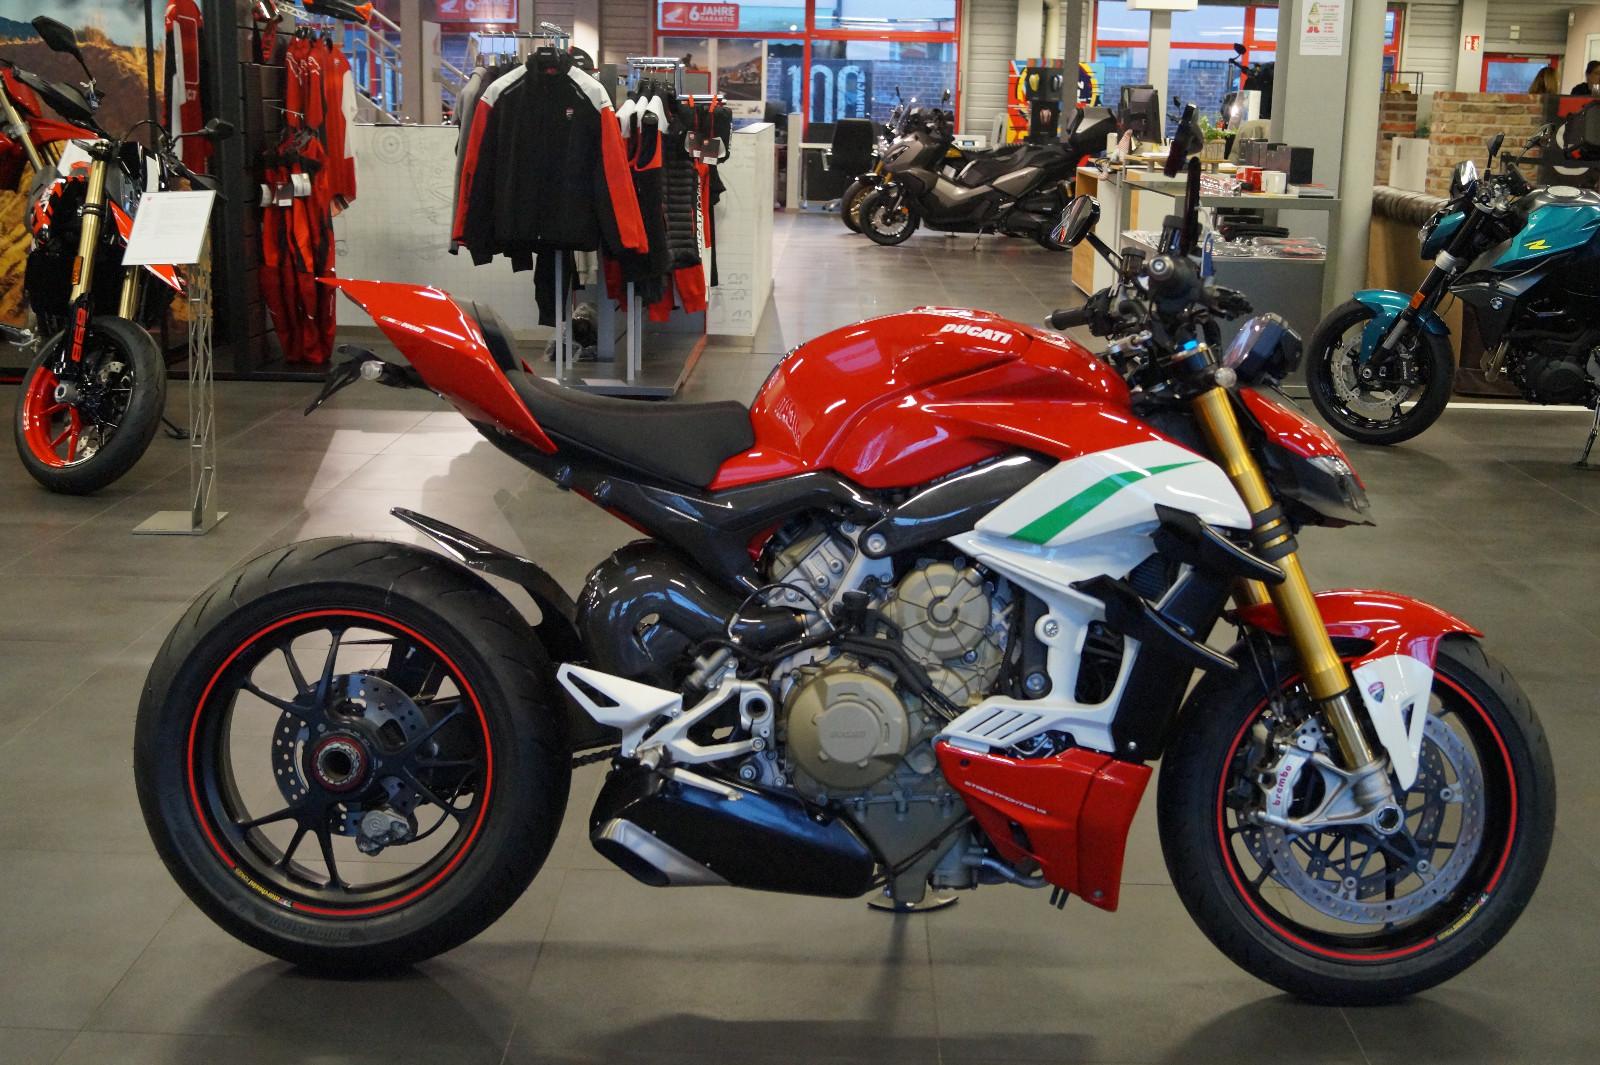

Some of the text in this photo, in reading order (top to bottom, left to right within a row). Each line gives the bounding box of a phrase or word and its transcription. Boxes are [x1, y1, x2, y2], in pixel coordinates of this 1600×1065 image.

[688, 5, 736, 21] 6 JAHRE
[940, 323, 1013, 344] DUCATI
[1272, 765, 1292, 806] brembo
